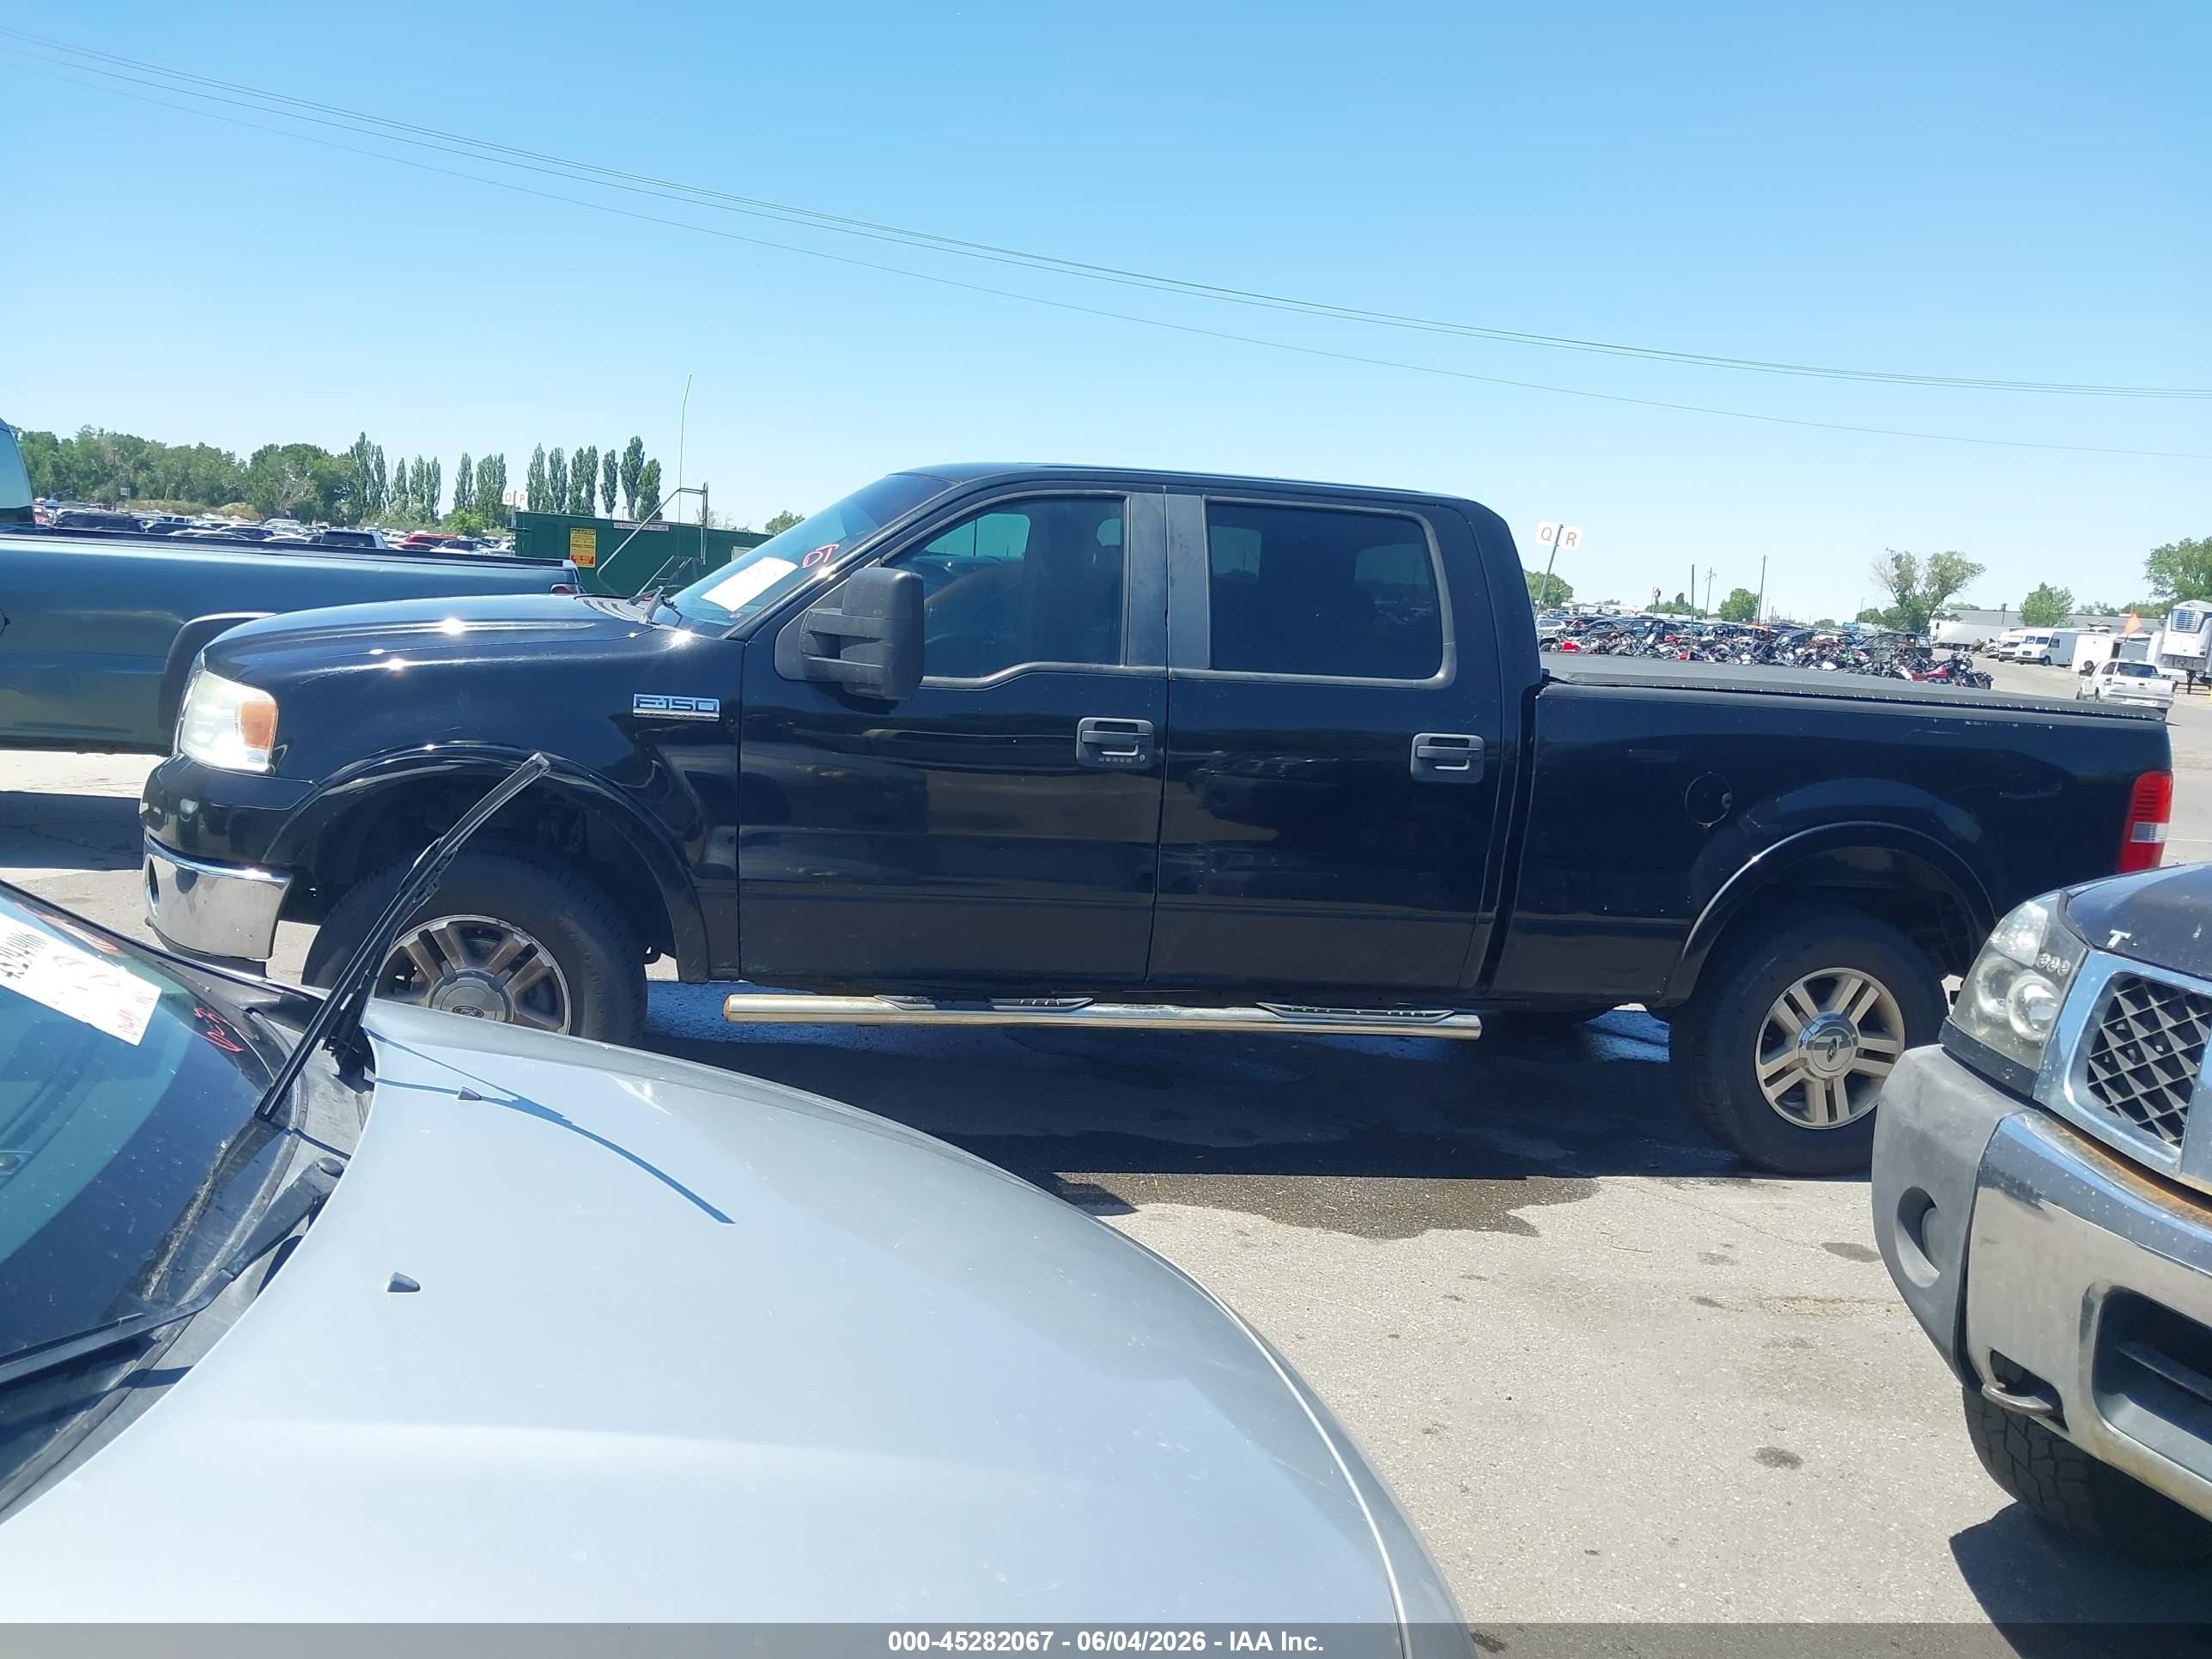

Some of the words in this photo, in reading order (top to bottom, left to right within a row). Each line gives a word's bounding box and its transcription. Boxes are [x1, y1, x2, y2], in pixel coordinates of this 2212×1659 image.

[520, 494, 526, 504] P
[1540, 526, 1553, 542] Q
[1565, 532, 1577, 548] R
[2106, 928, 2132, 949] T
